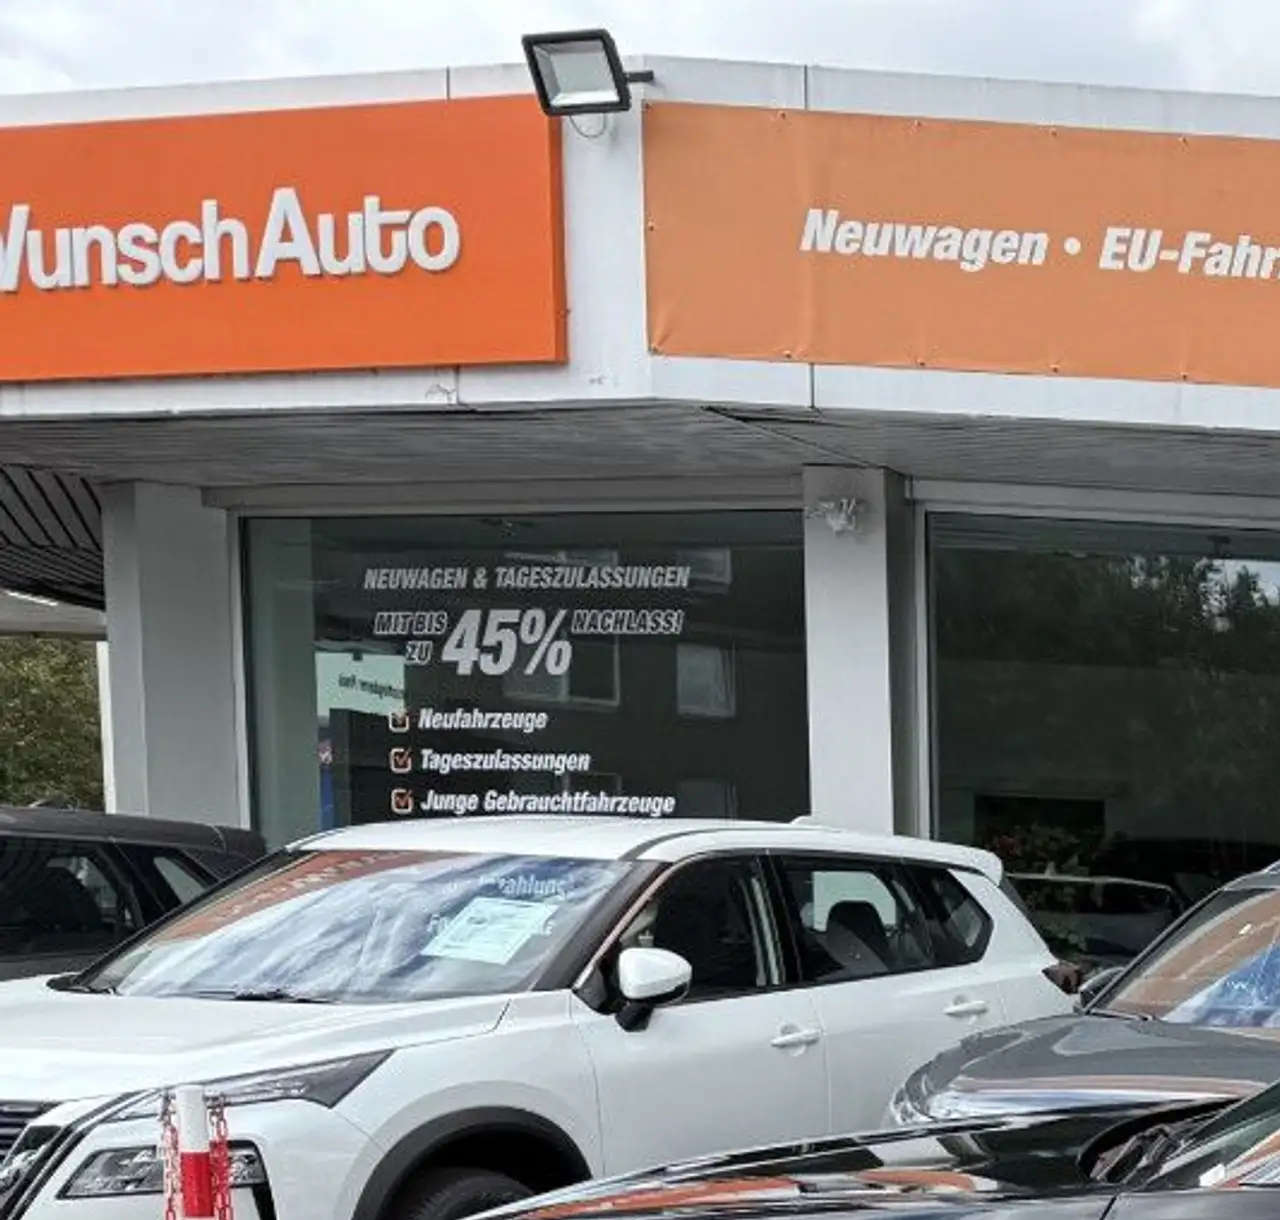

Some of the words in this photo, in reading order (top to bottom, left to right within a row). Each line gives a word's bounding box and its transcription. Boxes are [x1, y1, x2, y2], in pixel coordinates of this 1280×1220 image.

[800, 207, 1048, 272] Neuwagen
[364, 567, 468, 590] NEUWAGEN
[473, 566, 489, 590] &
[495, 565, 691, 589] TAGESZULASSUNGEN
[373, 611, 413, 635] MIT
[412, 611, 448, 635] BIS
[571, 608, 685, 635] NACHLASS!
[404, 640, 433, 665] ZU
[441, 608, 573, 676] 45%
[418, 707, 549, 733] Neufahrzeuge
[420, 748, 591, 775] Tageszulassungen
[420, 789, 479, 815] Junge
[483, 788, 677, 817] Gebrauchtfahrzeuge
